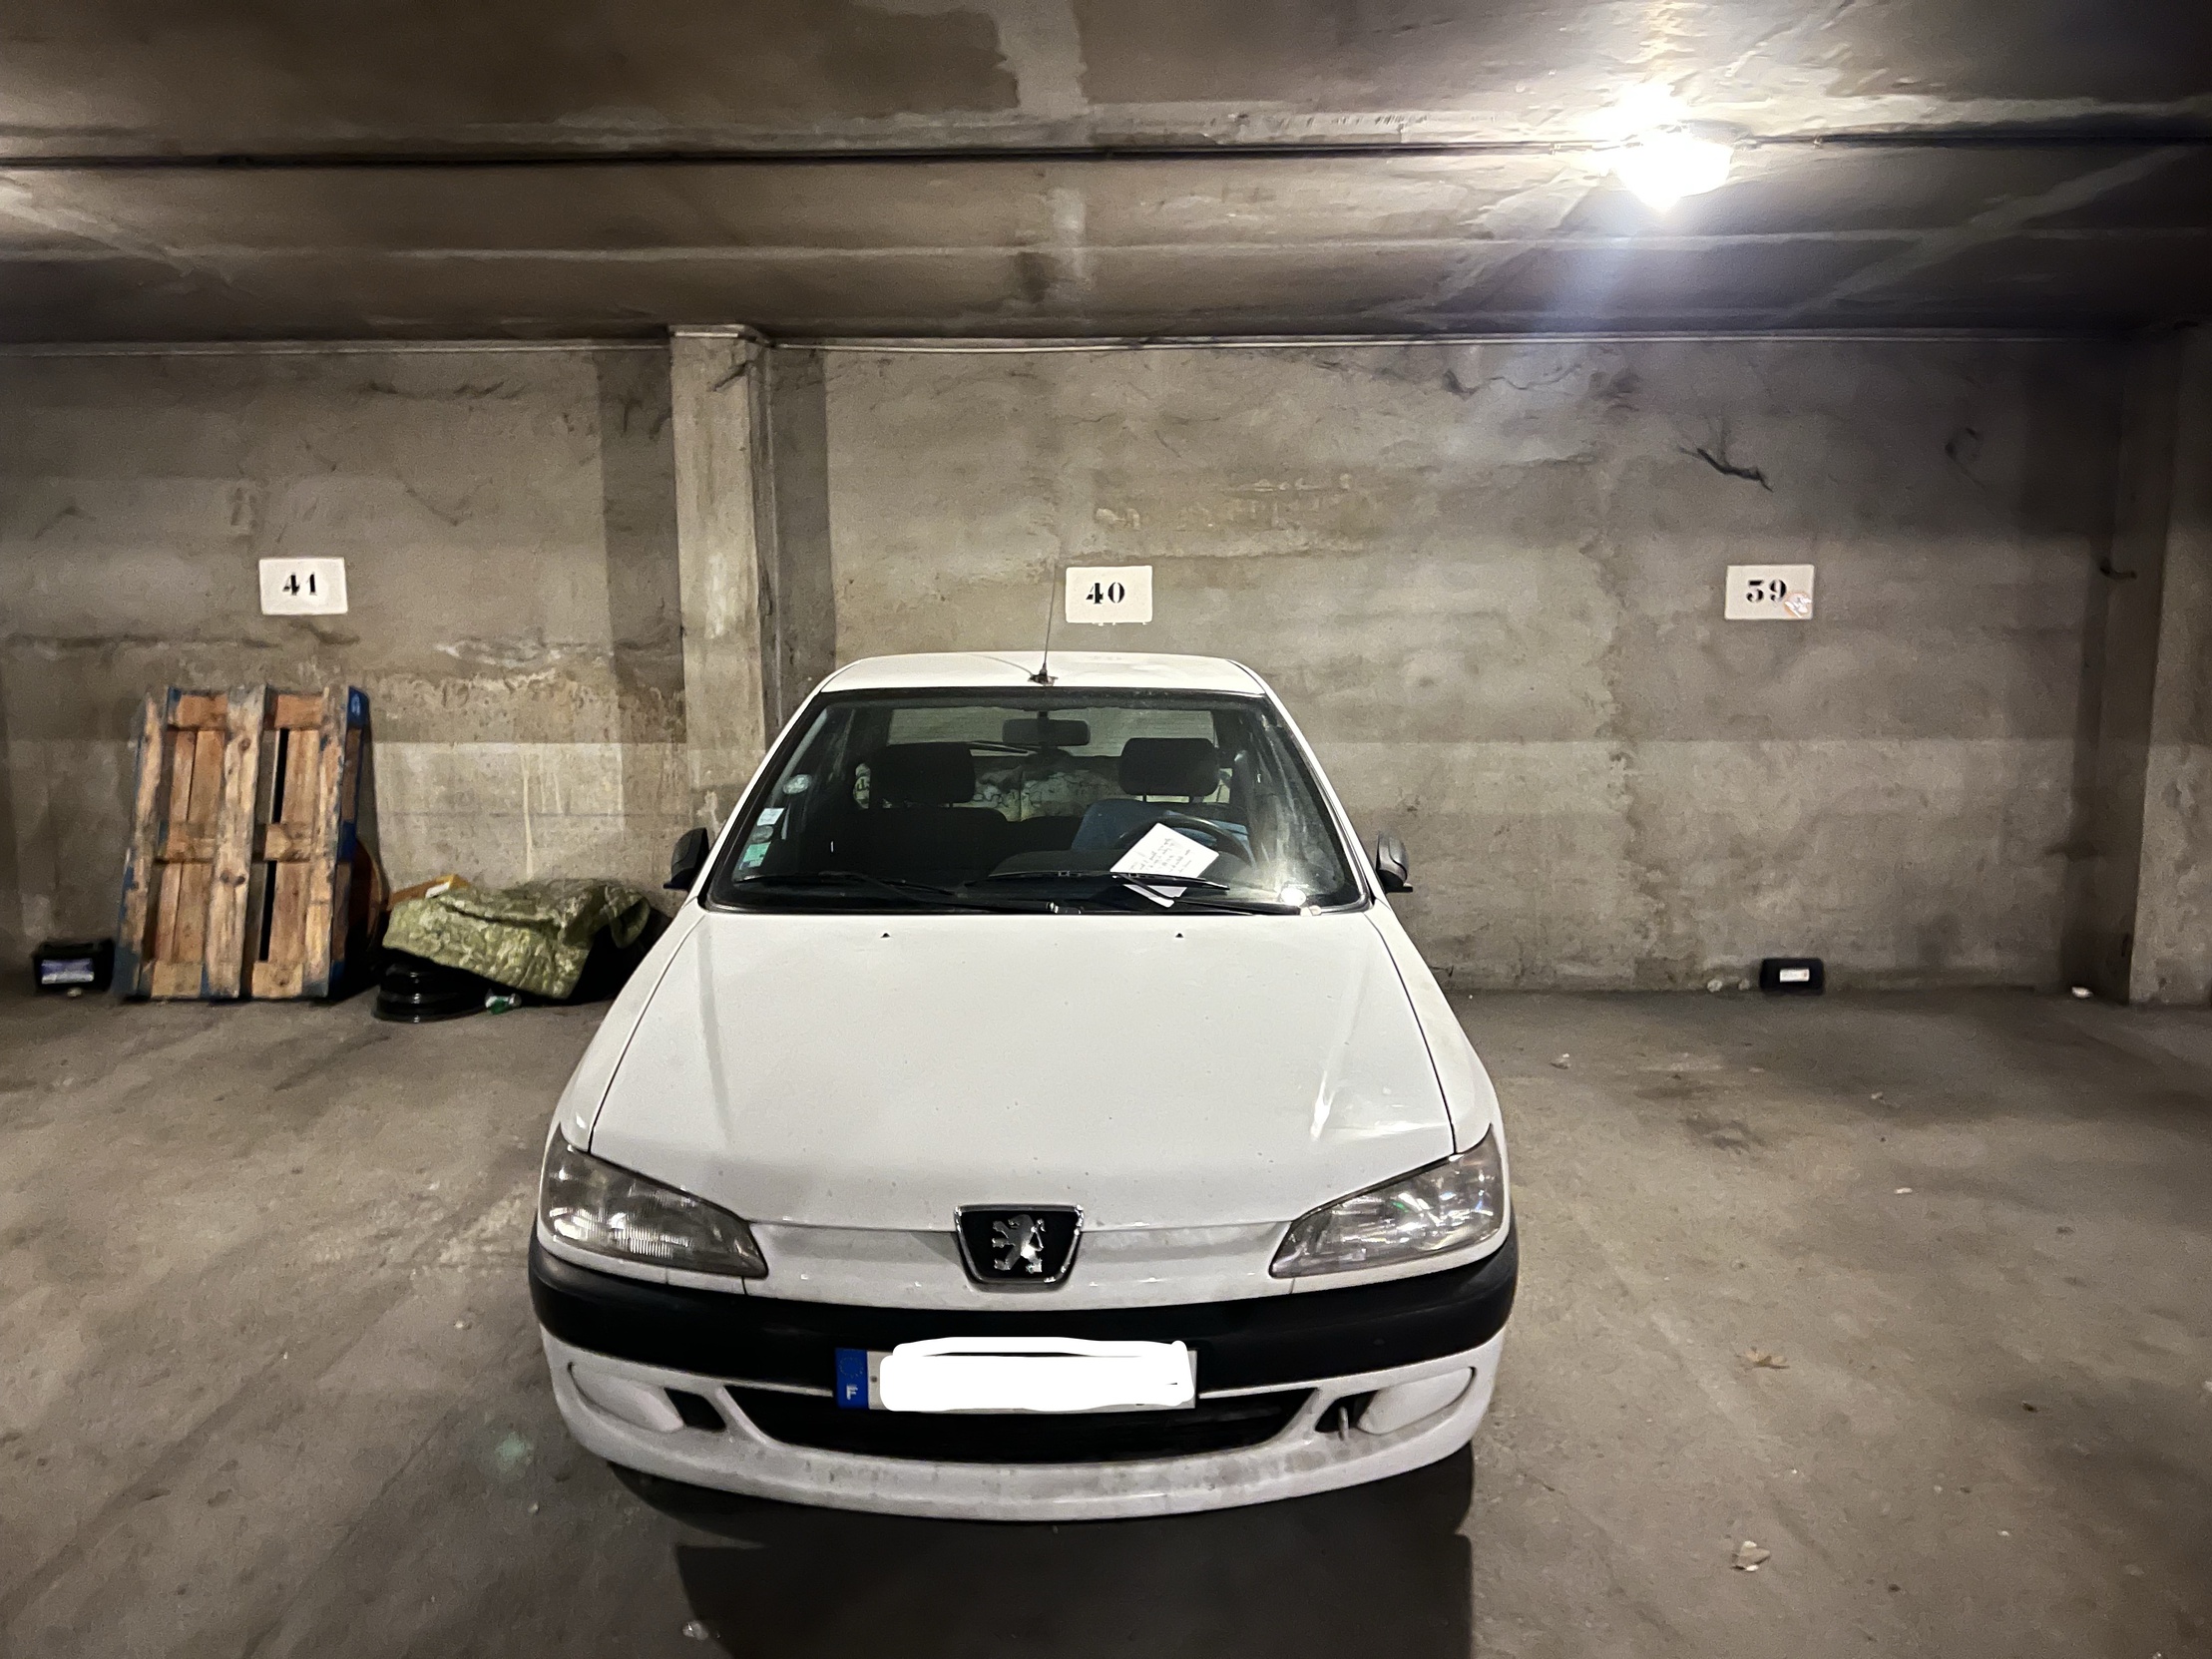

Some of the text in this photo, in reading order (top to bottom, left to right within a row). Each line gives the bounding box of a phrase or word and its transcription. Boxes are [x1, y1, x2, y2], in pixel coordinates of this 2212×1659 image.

[282, 572, 317, 596] 41
[1086, 582, 1125, 605] 40
[846, 1384, 858, 1401] F
